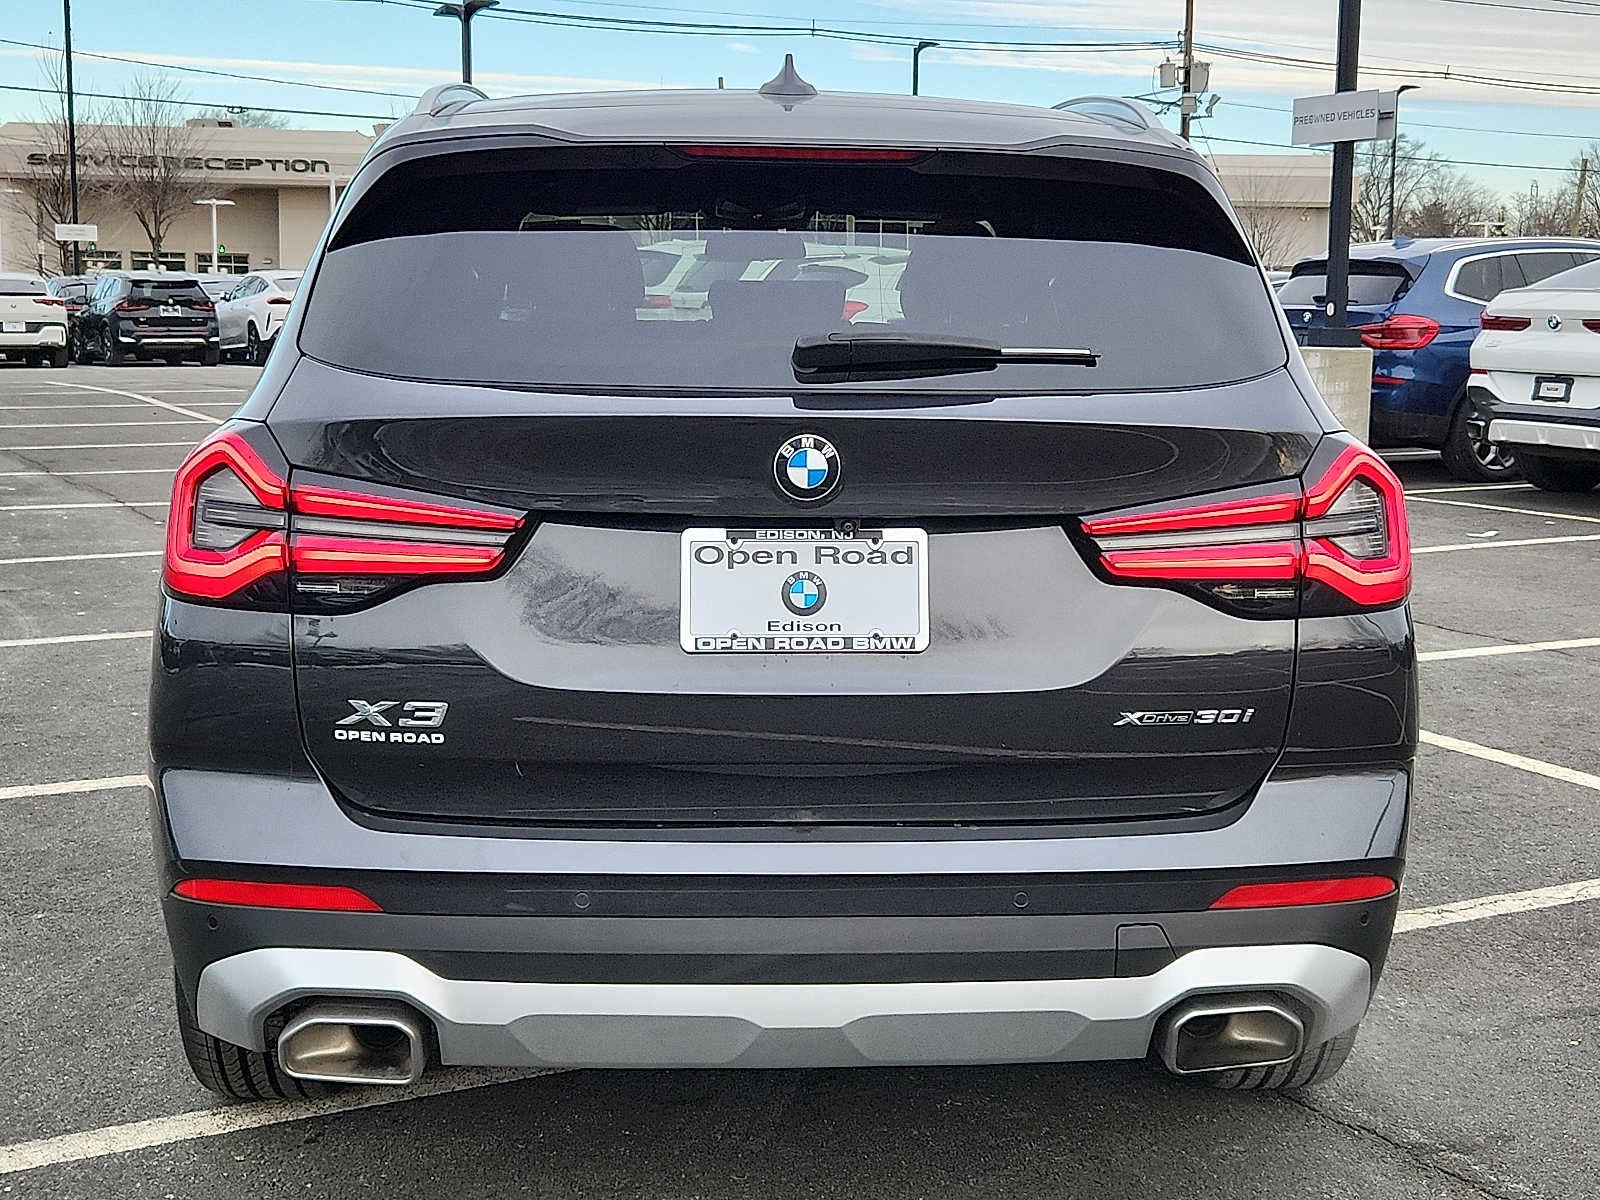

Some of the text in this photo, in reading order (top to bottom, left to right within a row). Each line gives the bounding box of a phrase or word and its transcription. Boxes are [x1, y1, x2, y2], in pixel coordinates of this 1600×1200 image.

[1337, 108, 1376, 121] VEHICLES
[161, 156, 330, 173] RECEPTION
[780, 436, 836, 460] BMW
[755, 530, 855, 540] EDISON, NJ
[694, 545, 914, 570] Open Road
[766, 620, 842, 633] Edison
[696, 637, 915, 650] OPEN ROAD BMW
[335, 699, 449, 728] X3
[334, 729, 445, 744] OPEN ROAD
